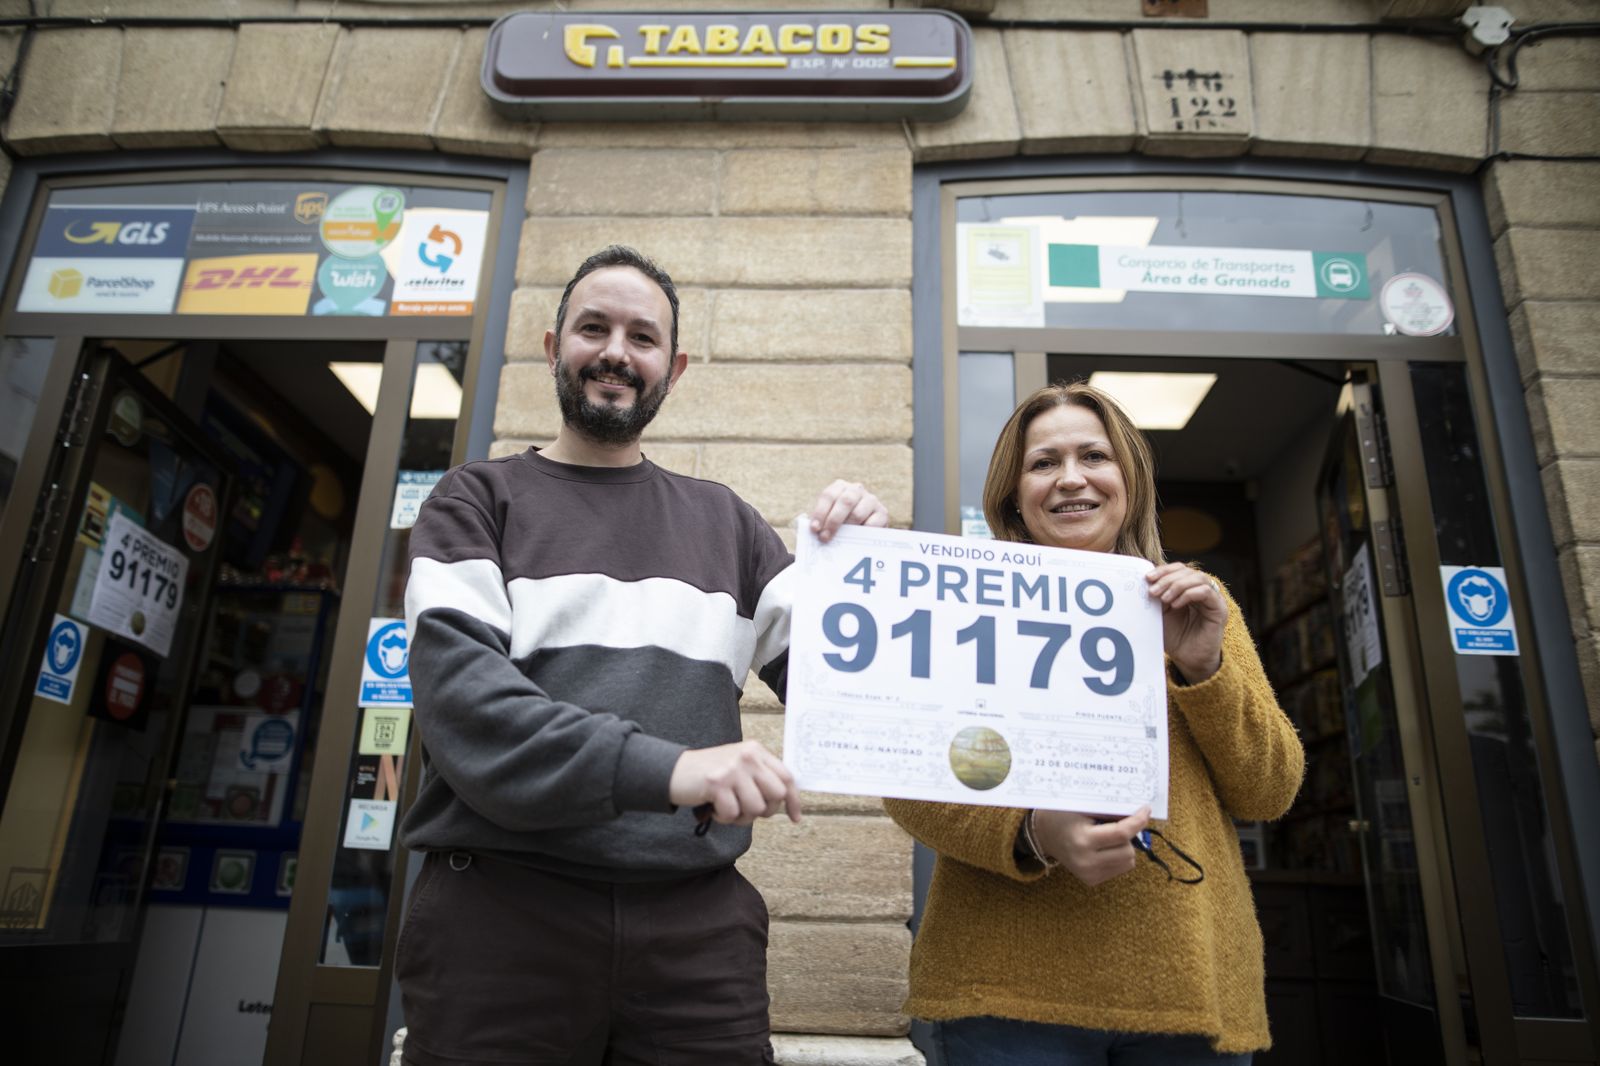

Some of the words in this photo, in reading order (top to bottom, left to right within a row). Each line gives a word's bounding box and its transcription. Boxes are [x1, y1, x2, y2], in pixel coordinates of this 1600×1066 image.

[638, 24, 891, 54] TABACOS
[852, 57, 890, 70] 002
[118, 221, 170, 245] GLS
[1117, 254, 1187, 269] Consorcio
[1192, 256, 1210, 270] de
[1213, 257, 1296, 275] Transportes
[85, 276, 154, 292] ParcelShop
[192, 267, 302, 291] DHL
[1188, 274, 1208, 286] de
[1214, 274, 1291, 289] Granada
[132, 539, 179, 580] PREMIO
[919, 543, 995, 562] VENDIDO
[1001, 550, 1042, 567] AQUÍ
[109, 549, 177, 611] 91179
[900, 561, 1114, 616] PREMIO
[822, 602, 1135, 697] 91179
[878, 746, 923, 756] NAVIDAD
[1034, 759, 1046, 767] 22
[1049, 760, 1061, 768] DE
[1064, 762, 1115, 772] DICIEMBRE
[1118, 766, 1139, 774] 2021
